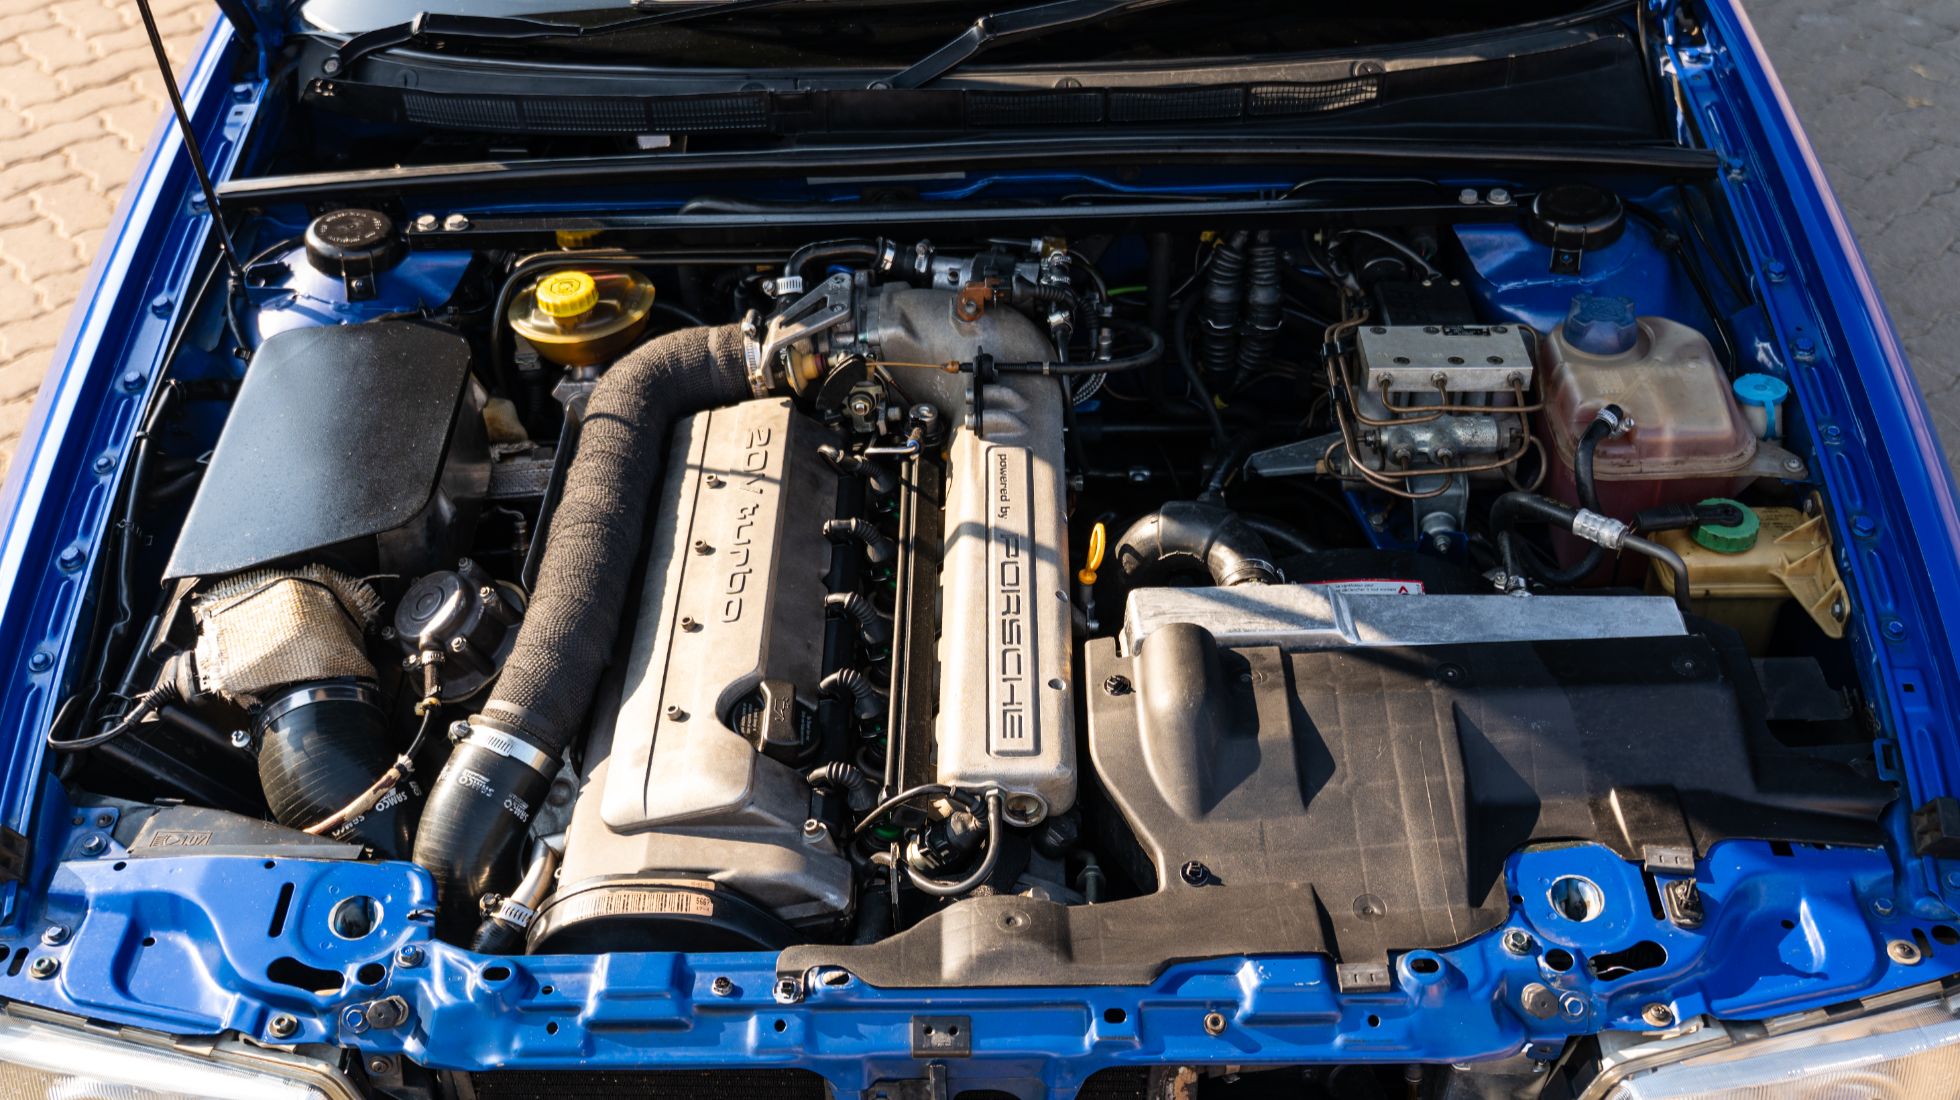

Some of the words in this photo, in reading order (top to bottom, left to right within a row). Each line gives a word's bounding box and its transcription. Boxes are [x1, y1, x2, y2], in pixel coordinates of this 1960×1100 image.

[739, 428, 772, 495] 20V
[997, 453, 1010, 502] powered
[997, 506, 1010, 519] by
[722, 503, 759, 623] turbo
[1000, 533, 1023, 739] PORSCHE
[375, 791, 408, 812] SAMCO
[458, 776, 495, 798] SAMCO
[503, 799, 529, 823] SAMCO
